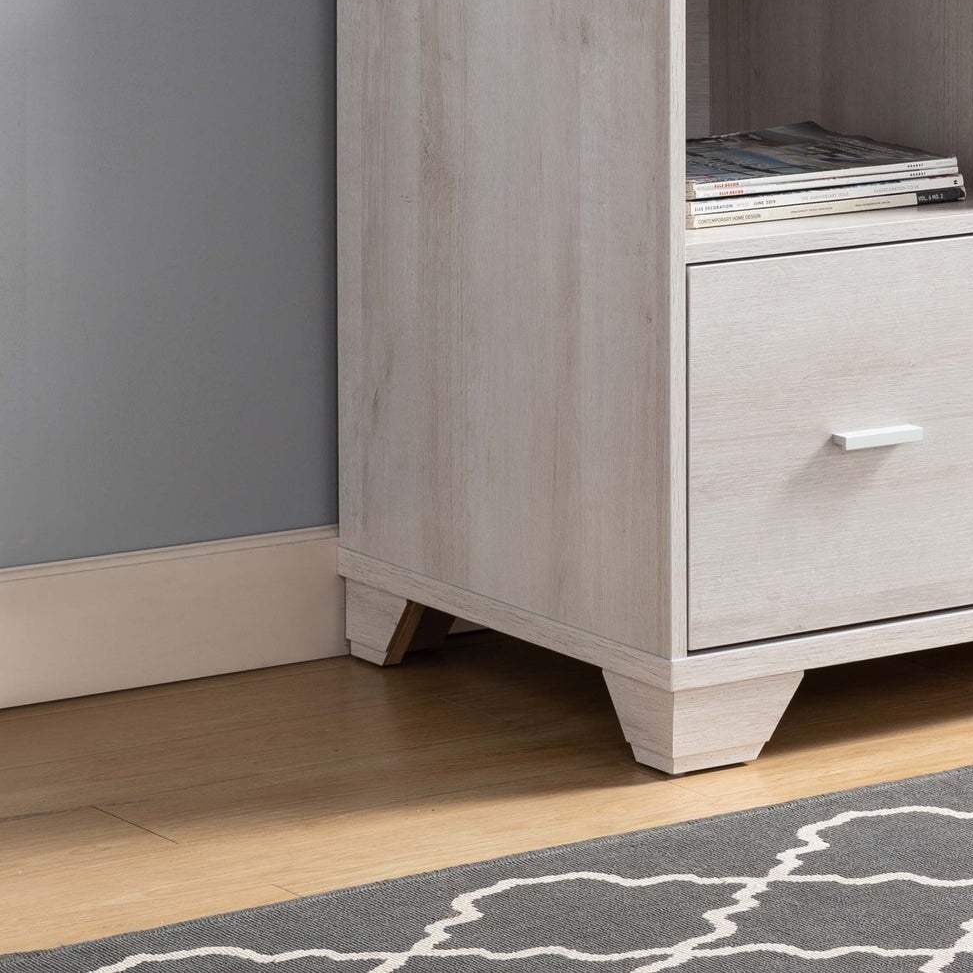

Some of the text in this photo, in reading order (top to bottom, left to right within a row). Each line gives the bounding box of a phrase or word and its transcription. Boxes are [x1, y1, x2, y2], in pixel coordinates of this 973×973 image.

[697, 213, 762, 225] CONTEMPORARY HOME DESIGN
